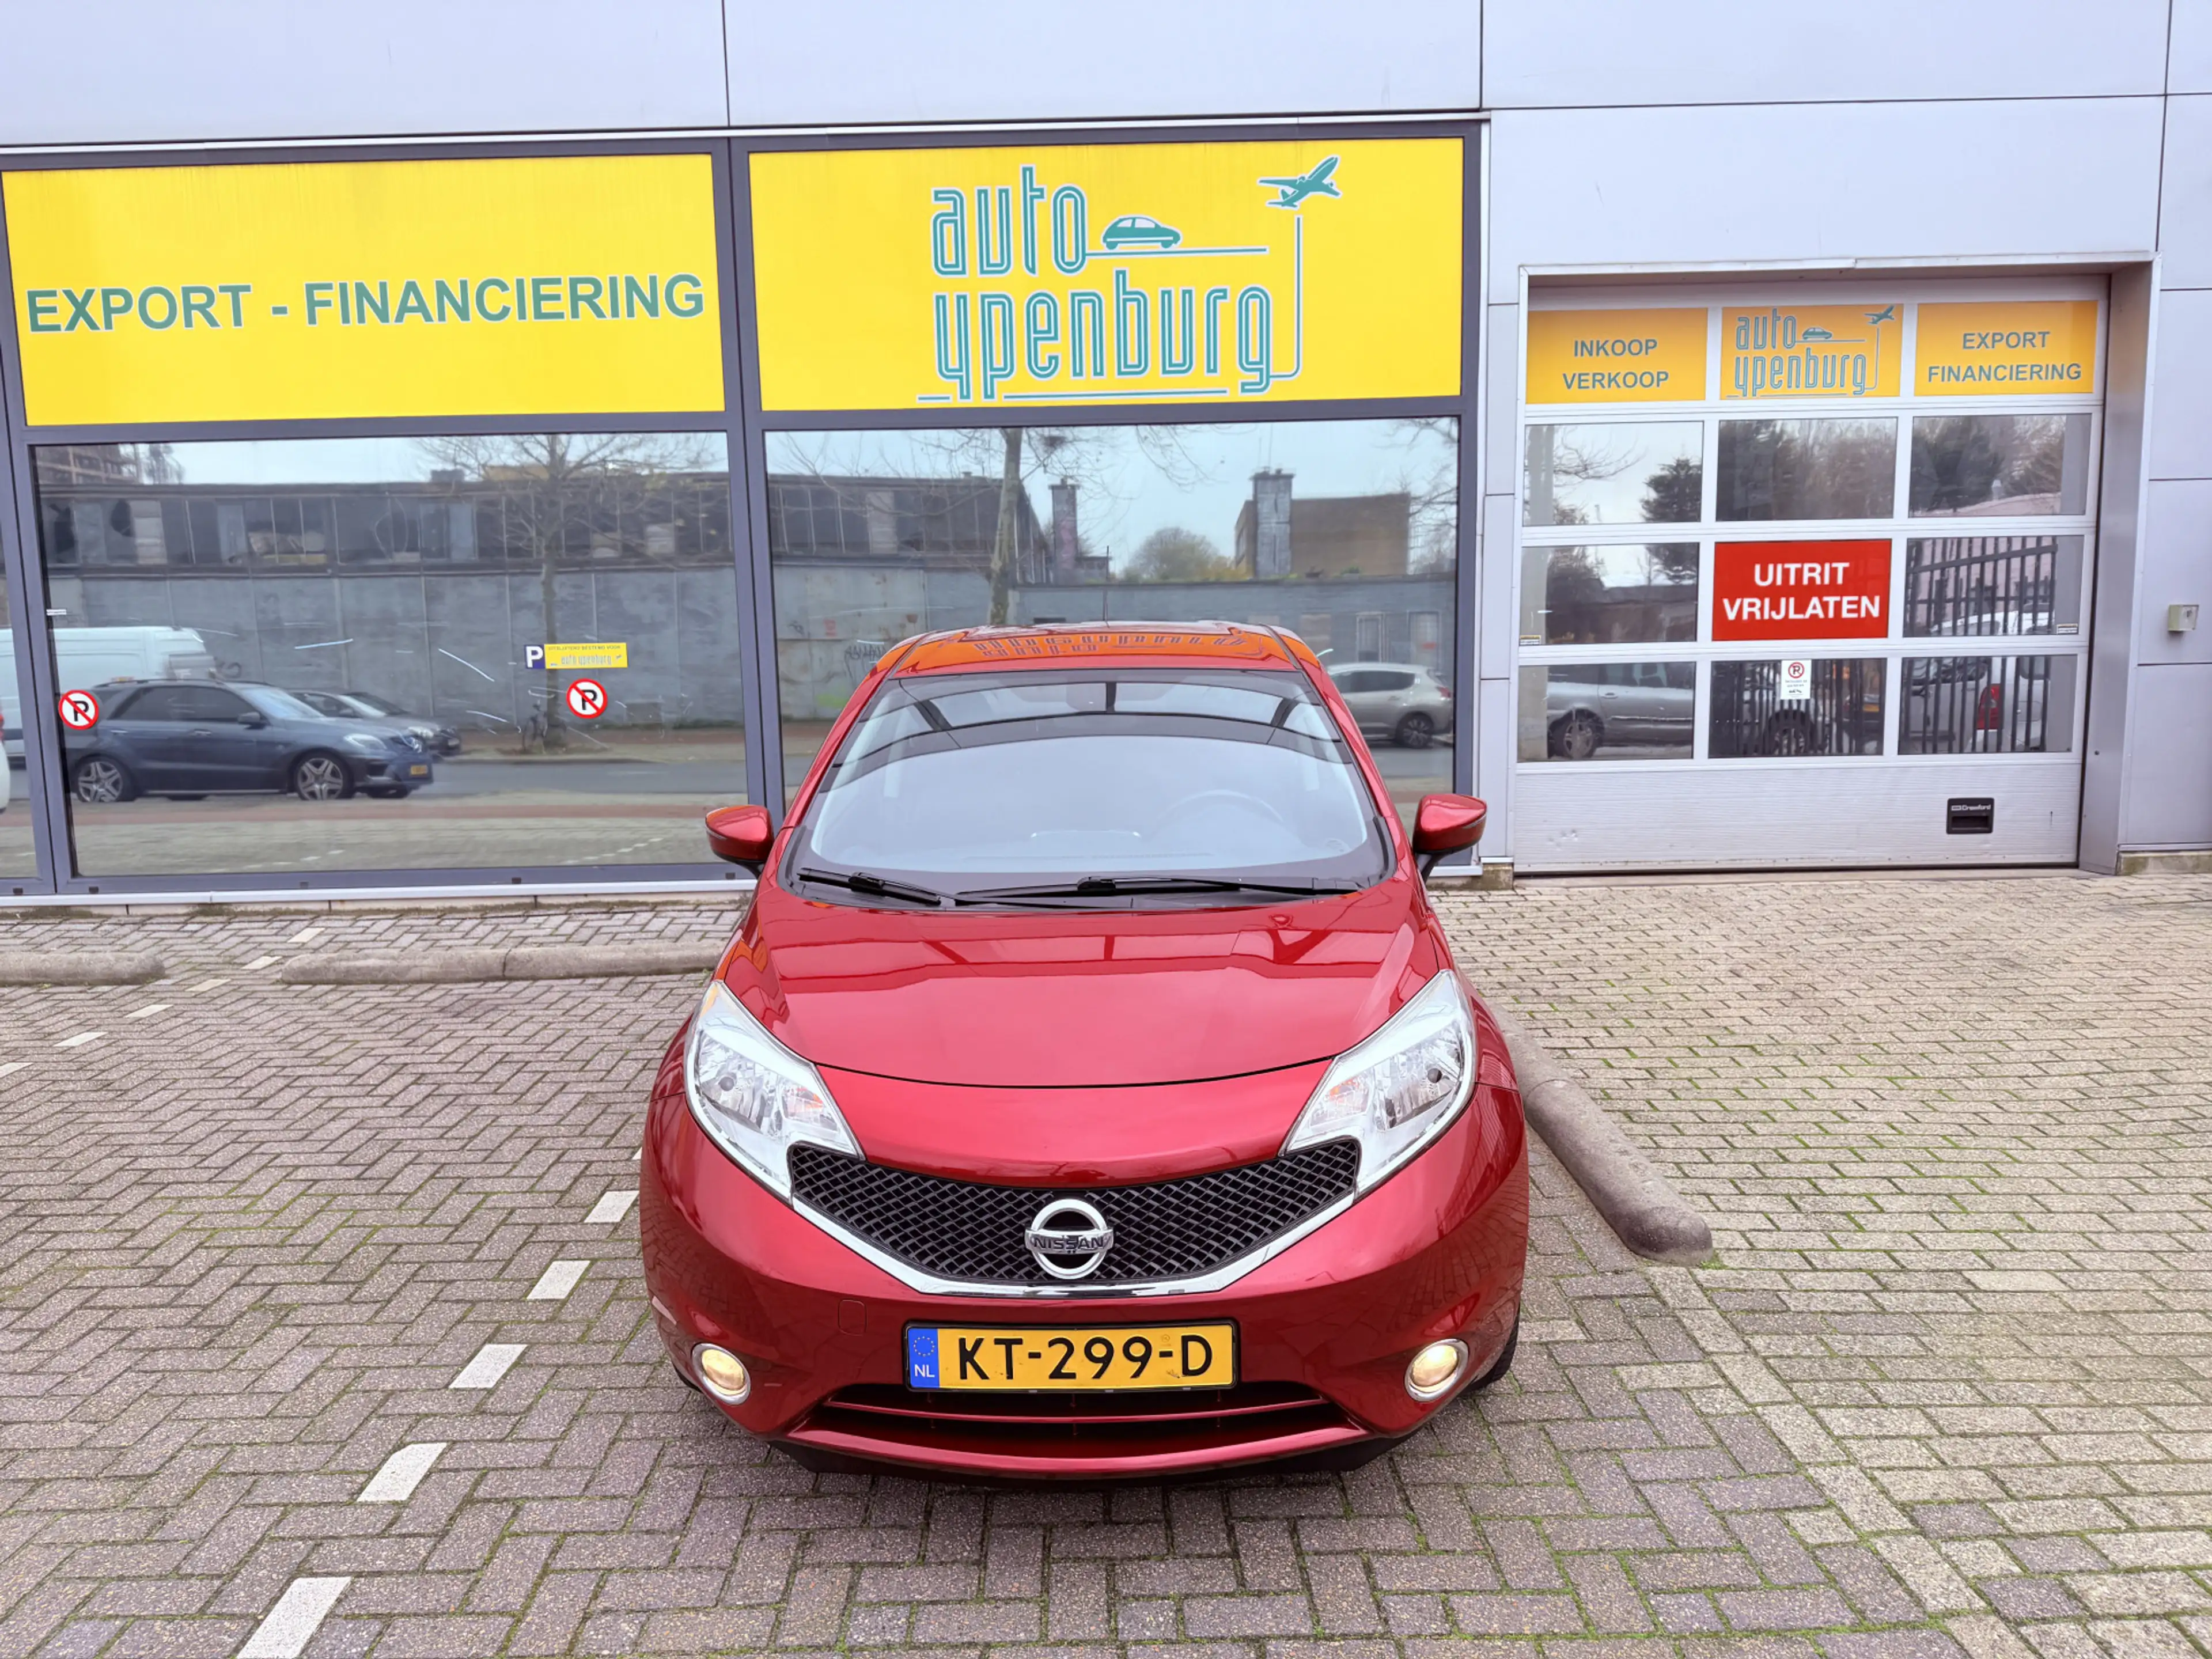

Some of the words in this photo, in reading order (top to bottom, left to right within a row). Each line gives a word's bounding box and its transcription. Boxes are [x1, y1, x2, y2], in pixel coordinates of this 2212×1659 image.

[932, 165, 1087, 276] auto
[26, 283, 252, 332] EXPORT
[305, 273, 704, 326] FINANCIERING
[934, 268, 1272, 400] ypenburg
[1736, 308, 1796, 350] auto
[1962, 331, 2051, 350] EXPORT
[1573, 339, 1658, 357] INKOOP
[1562, 371, 1669, 390] VERKOOP
[1734, 347, 1866, 397] ypenburg
[1927, 362, 2082, 382] FINANCIERING
[1754, 562, 1850, 587] UITRIT
[1723, 595, 1880, 620] VRIJLATEN
[525, 646, 543, 668] P
[1034, 1237, 1104, 1249] NISSAN
[914, 1363, 935, 1378] NL
[957, 1334, 1213, 1380] KT-299-D
